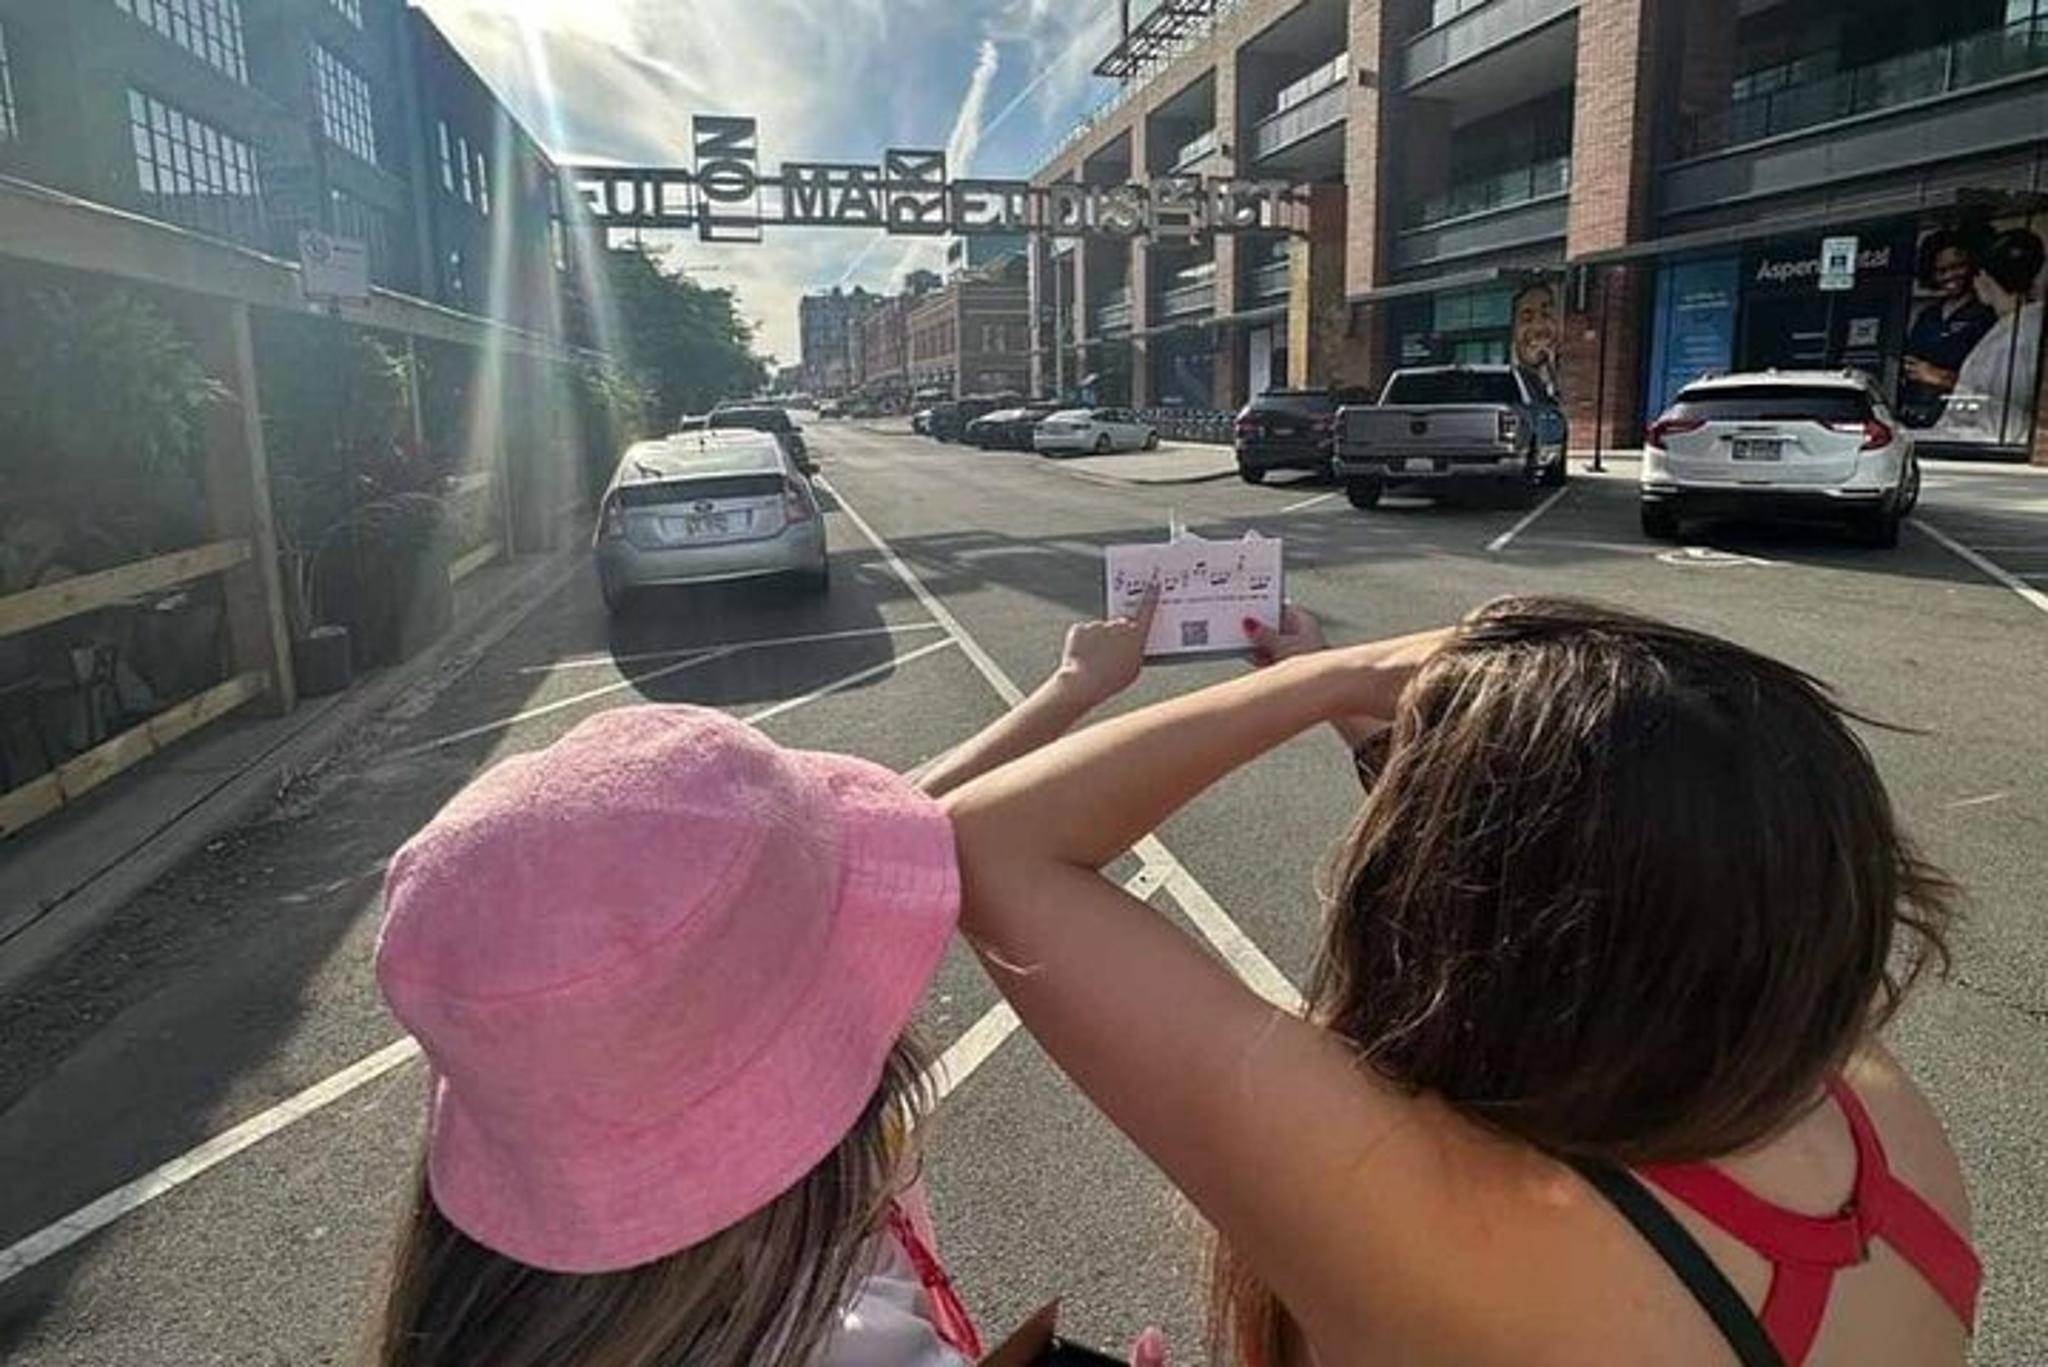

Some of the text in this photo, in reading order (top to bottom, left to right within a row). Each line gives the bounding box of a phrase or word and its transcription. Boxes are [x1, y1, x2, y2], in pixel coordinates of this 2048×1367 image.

[570, 115, 758, 240] FULTON
[783, 150, 1026, 233] MARKET
[1755, 257, 1823, 284] Aspen
